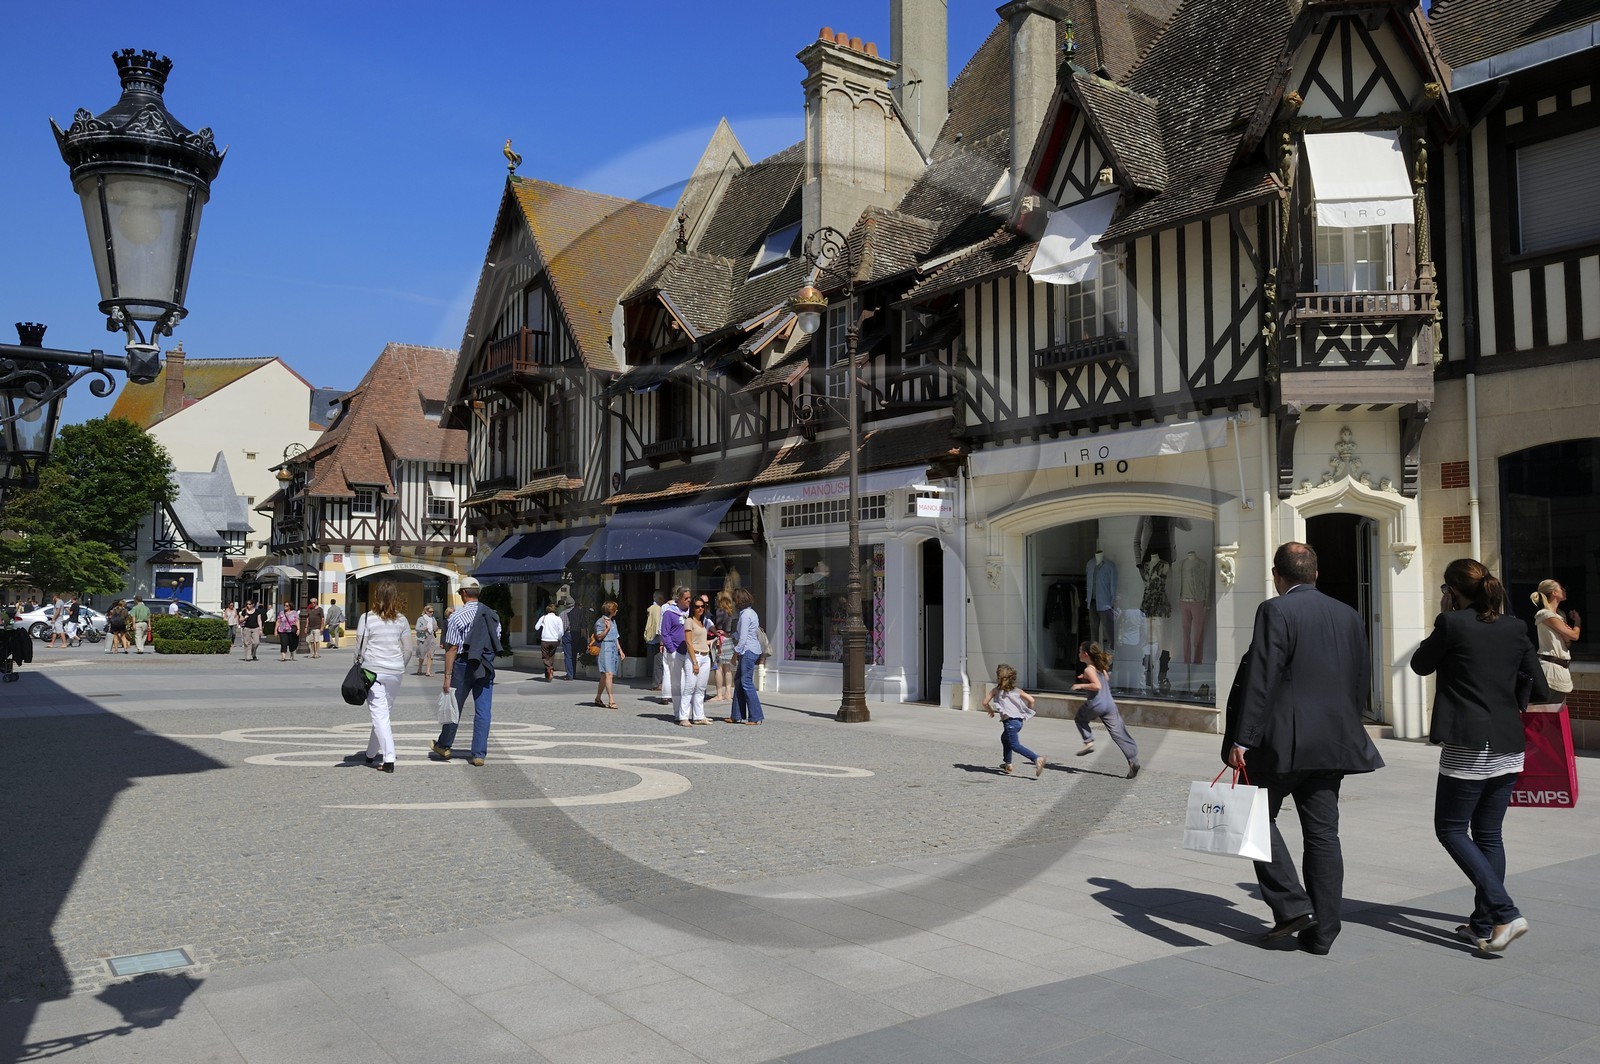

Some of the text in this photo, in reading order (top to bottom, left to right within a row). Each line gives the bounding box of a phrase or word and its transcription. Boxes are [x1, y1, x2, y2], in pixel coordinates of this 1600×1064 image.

[1343, 208, 1386, 218] IRO
[1063, 445, 1110, 463] IRO
[1074, 459, 1129, 478] IRO
[802, 482, 851, 498] MANOUSH
[918, 504, 949, 512] MANOUSH
